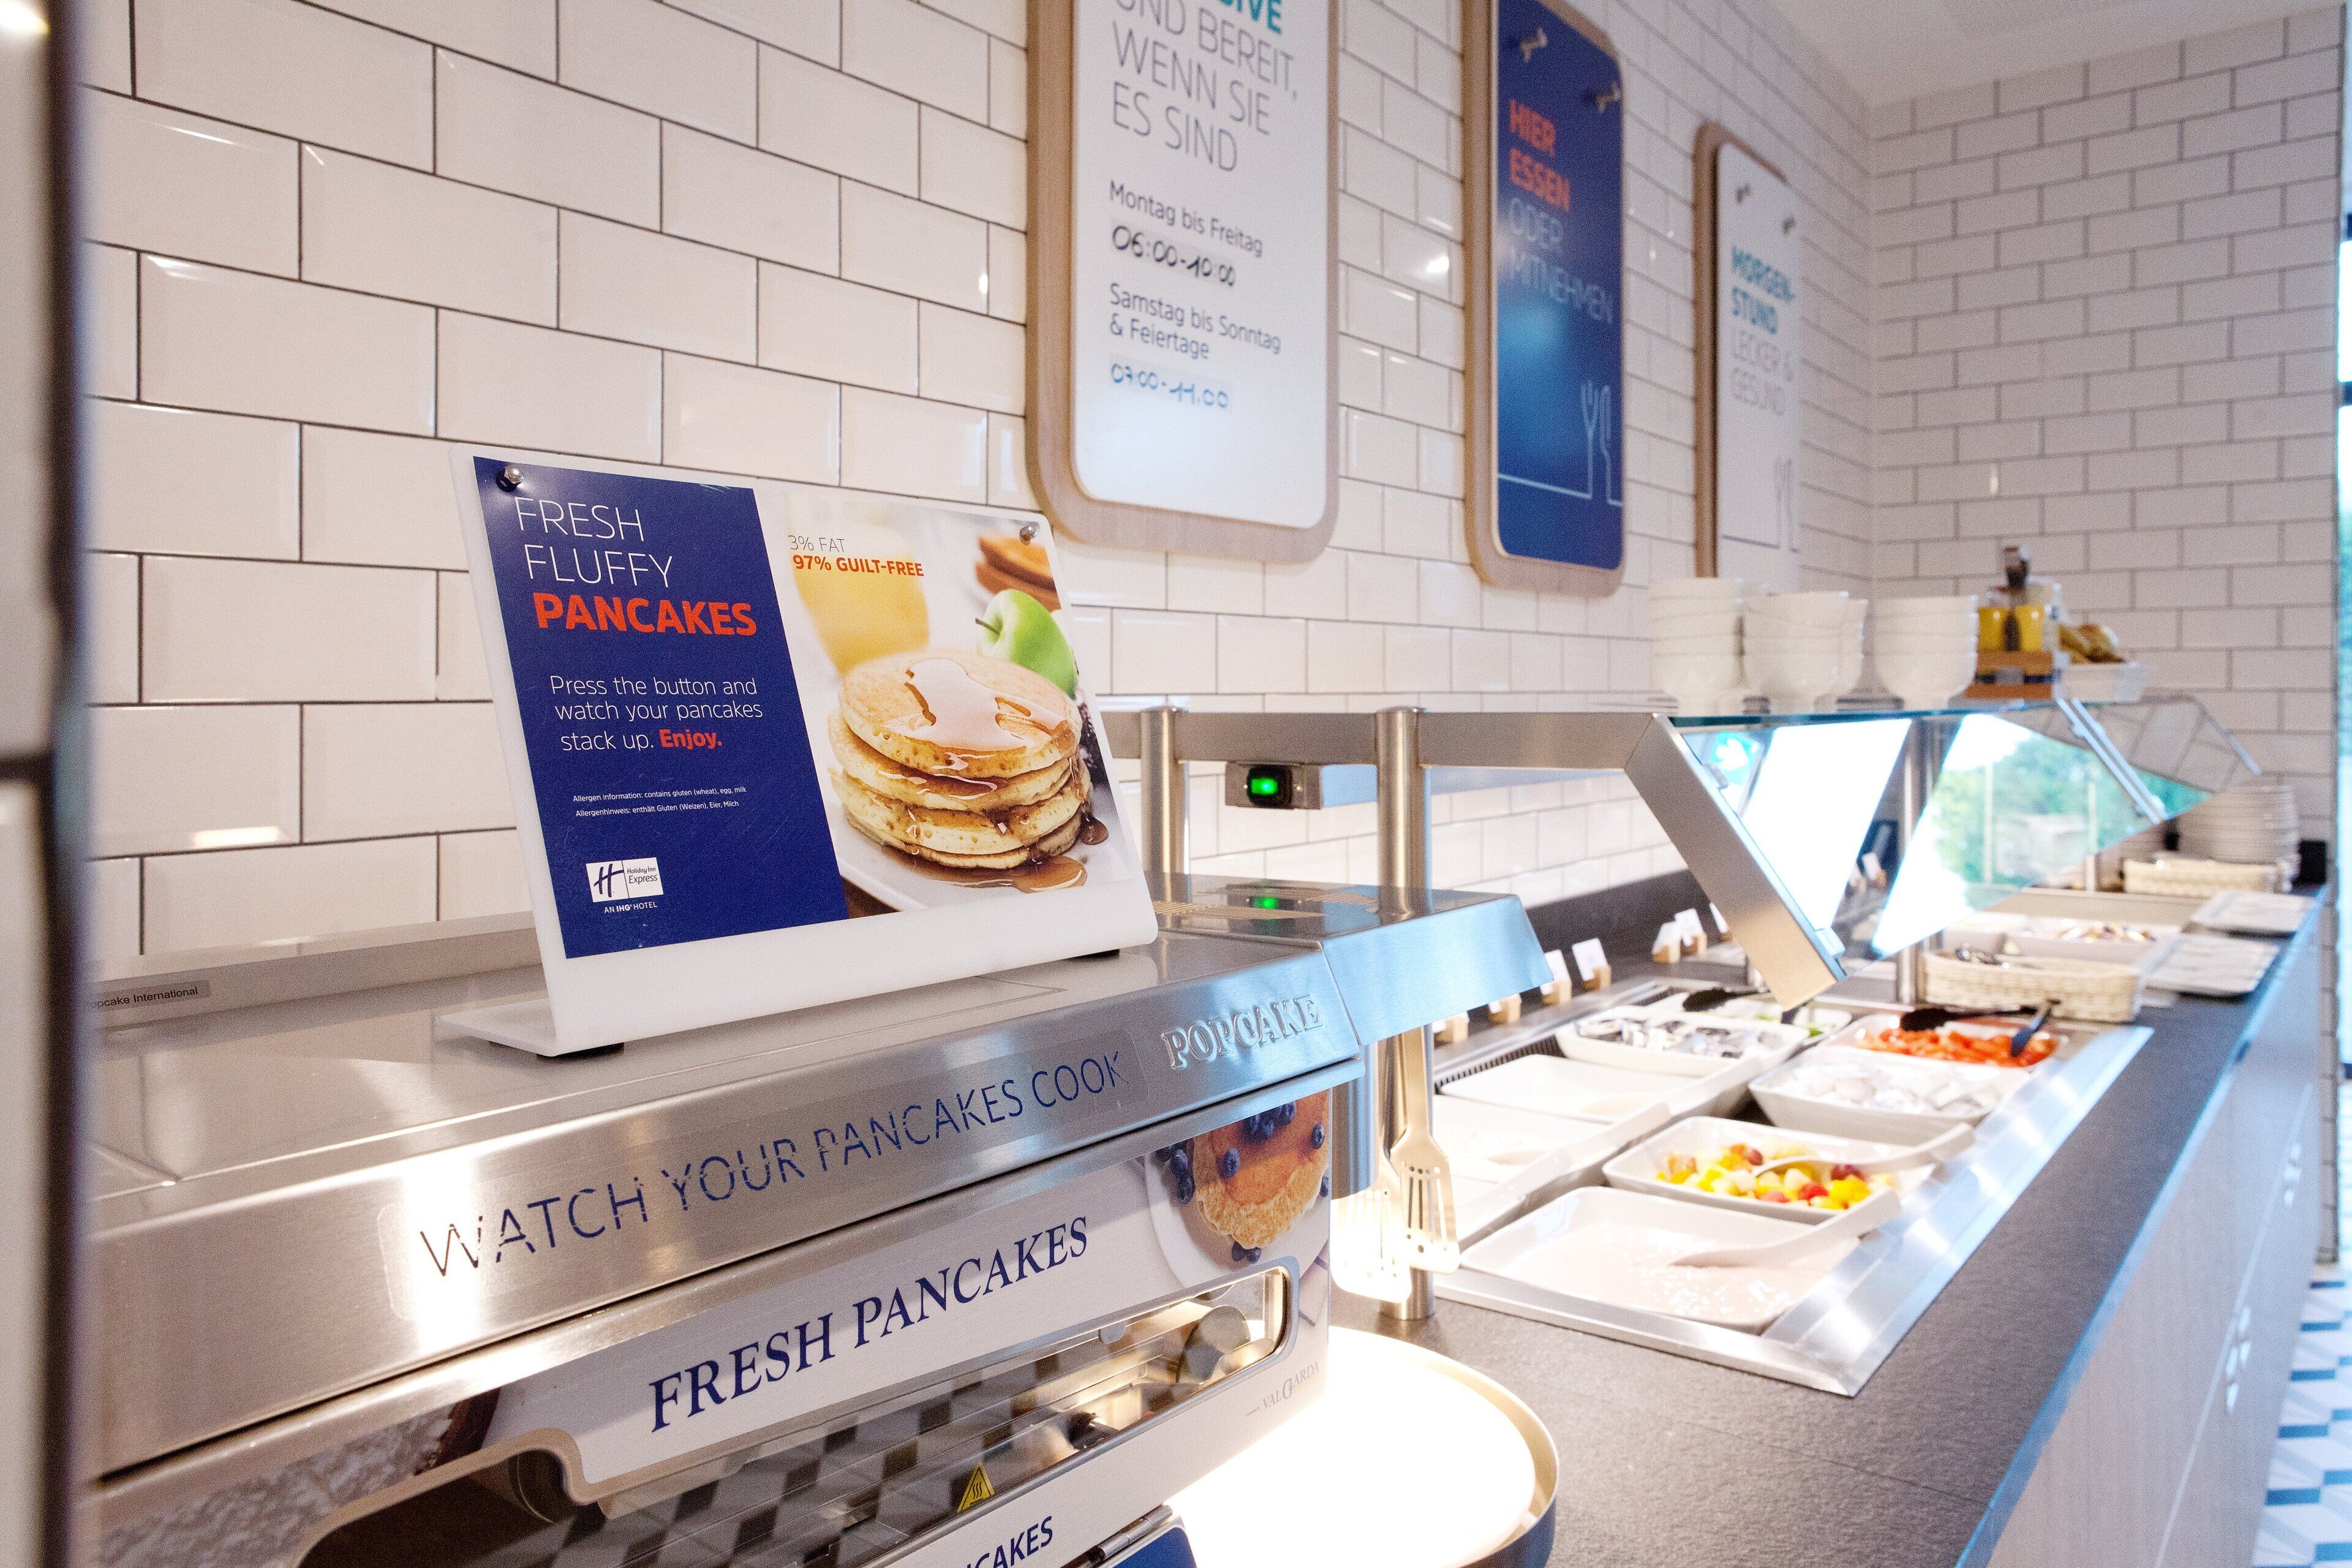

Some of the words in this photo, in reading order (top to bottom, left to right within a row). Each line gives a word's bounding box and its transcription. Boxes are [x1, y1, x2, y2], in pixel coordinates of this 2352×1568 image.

[1115, 0, 1186, 36] ND
[1112, 20, 1217, 111] WENN
[1229, 80, 1270, 135] SIE
[1112, 81, 1152, 137] ES
[1165, 105, 1238, 172] SIND
[1510, 99, 1556, 157] HIER
[1510, 148, 1570, 213] ESSEN
[1109, 180, 1177, 227] Montag
[1182, 208, 1205, 235] bis
[1210, 217, 1264, 257] Freitag
[1109, 313, 1123, 337] &
[1130, 317, 1210, 360] Feiertage
[1110, 282, 1185, 327] Samstag
[1191, 306, 1214, 333] bis
[1219, 315, 1282, 355] Sonntag
[514, 496, 644, 542] FRESH
[524, 544, 673, 588] FLUFFY
[788, 535, 814, 551] 3%
[819, 537, 845, 552] FAT
[793, 554, 832, 571] 97%
[836, 557, 924, 577] GUILT-FREE
[532, 592, 757, 636] PANCAKES
[550, 676, 608, 695] Press
[612, 676, 647, 695] the
[653, 676, 717, 695] button
[722, 677, 758, 696] and
[554, 700, 619, 720] watch
[625, 703, 669, 722] your
[676, 700, 763, 722] pancakes
[560, 730, 617, 752] stack
[622, 734, 655, 752] up.
[659, 729, 723, 750] Enjoy.
[576, 807, 631, 817] Allergenhinweis:
[632, 805, 656, 813] enthält
[603, 793, 643, 801] information:
[628, 875, 658, 884] Express
[85, 995, 130, 1009] opcake
[134, 986, 198, 1003] International
[1160, 995, 1323, 1070] POPCAKE
[420, 1175, 648, 1276] WATCH
[661, 1138, 805, 1211] YOUR
[813, 1079, 1023, 1172] PANCAKES
[1031, 1051, 1129, 1109] COOK
[649, 1313, 835, 1433] FRESH
[852, 1216, 1088, 1349] PANCAKES
[967, 1515, 1053, 1568] CAKES
